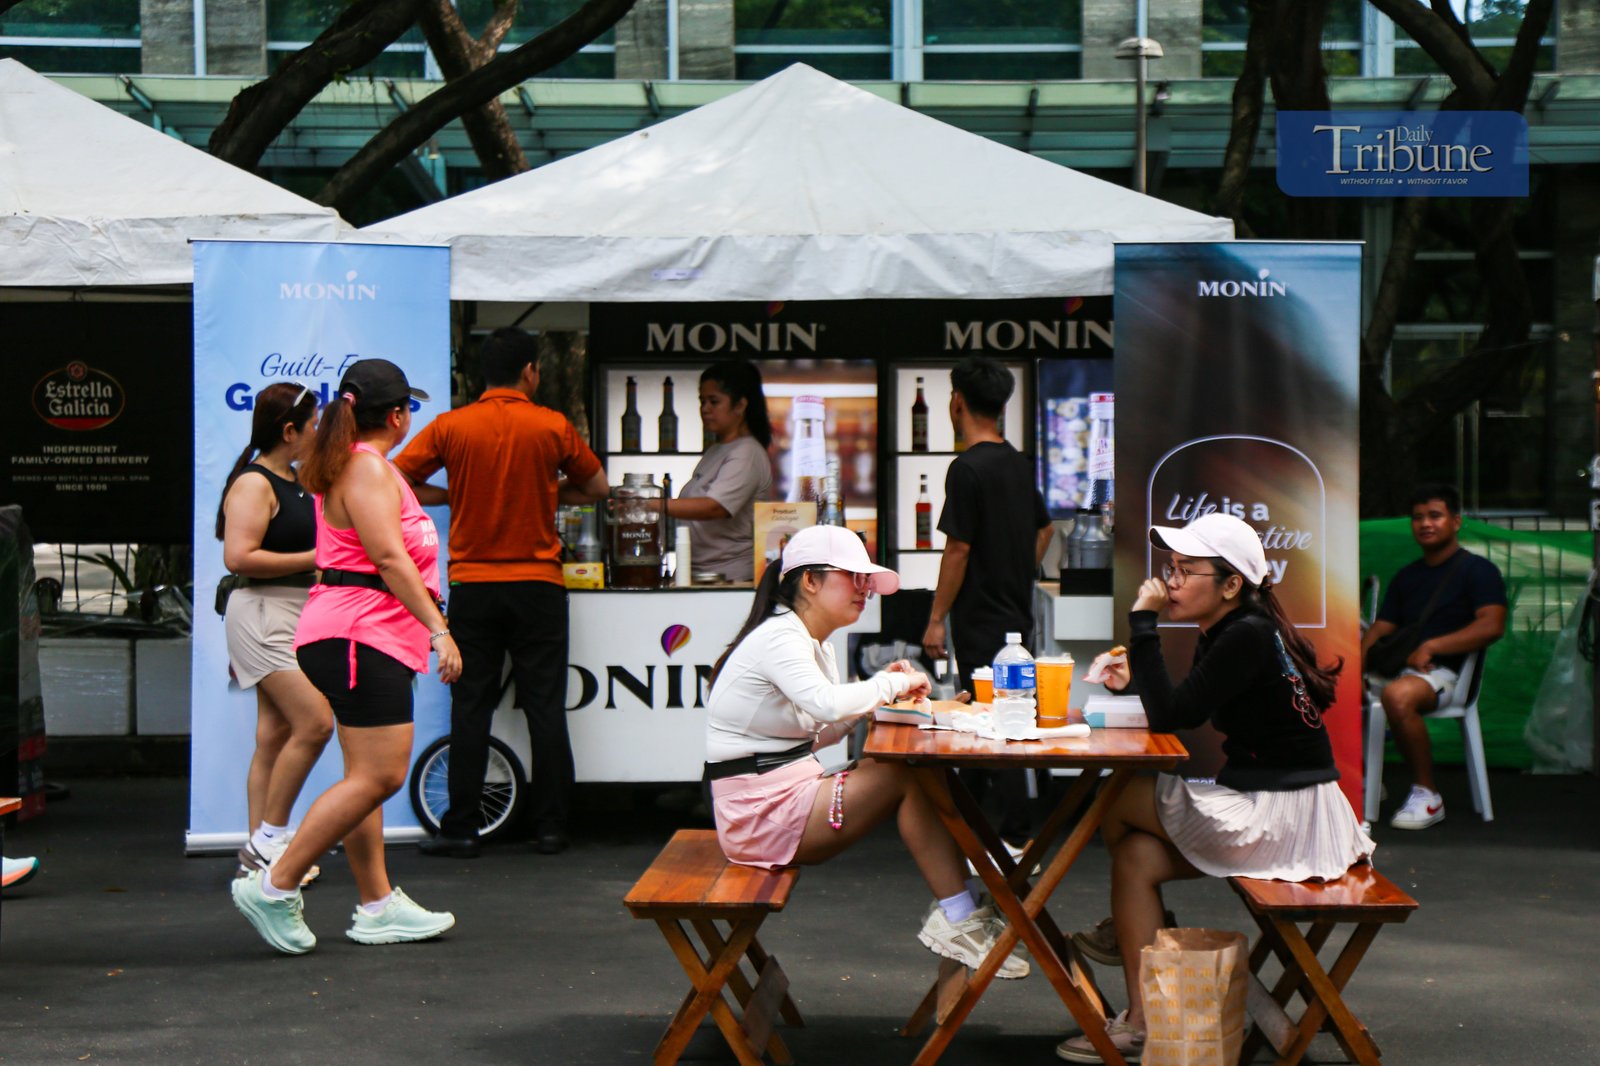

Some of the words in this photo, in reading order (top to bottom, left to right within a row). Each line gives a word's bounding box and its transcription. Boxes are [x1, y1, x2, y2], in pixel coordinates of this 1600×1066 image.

[279, 273, 377, 300] MONIN
[1198, 271, 1287, 298] MONIN
[645, 322, 818, 352] MONIN
[944, 320, 1114, 350] MONIN
[260, 353, 360, 378] Guilt-F
[45, 380, 113, 398] Estrella
[48, 397, 111, 417] Galicia
[11, 456, 93, 465] FAMILY-OWNED
[96, 456, 150, 465] BREWERY
[42, 446, 118, 454] INDEPENDENT
[1165, 492, 1218, 523] Life
[1223, 496, 1246, 521] is
[1251, 503, 1270, 521] a
